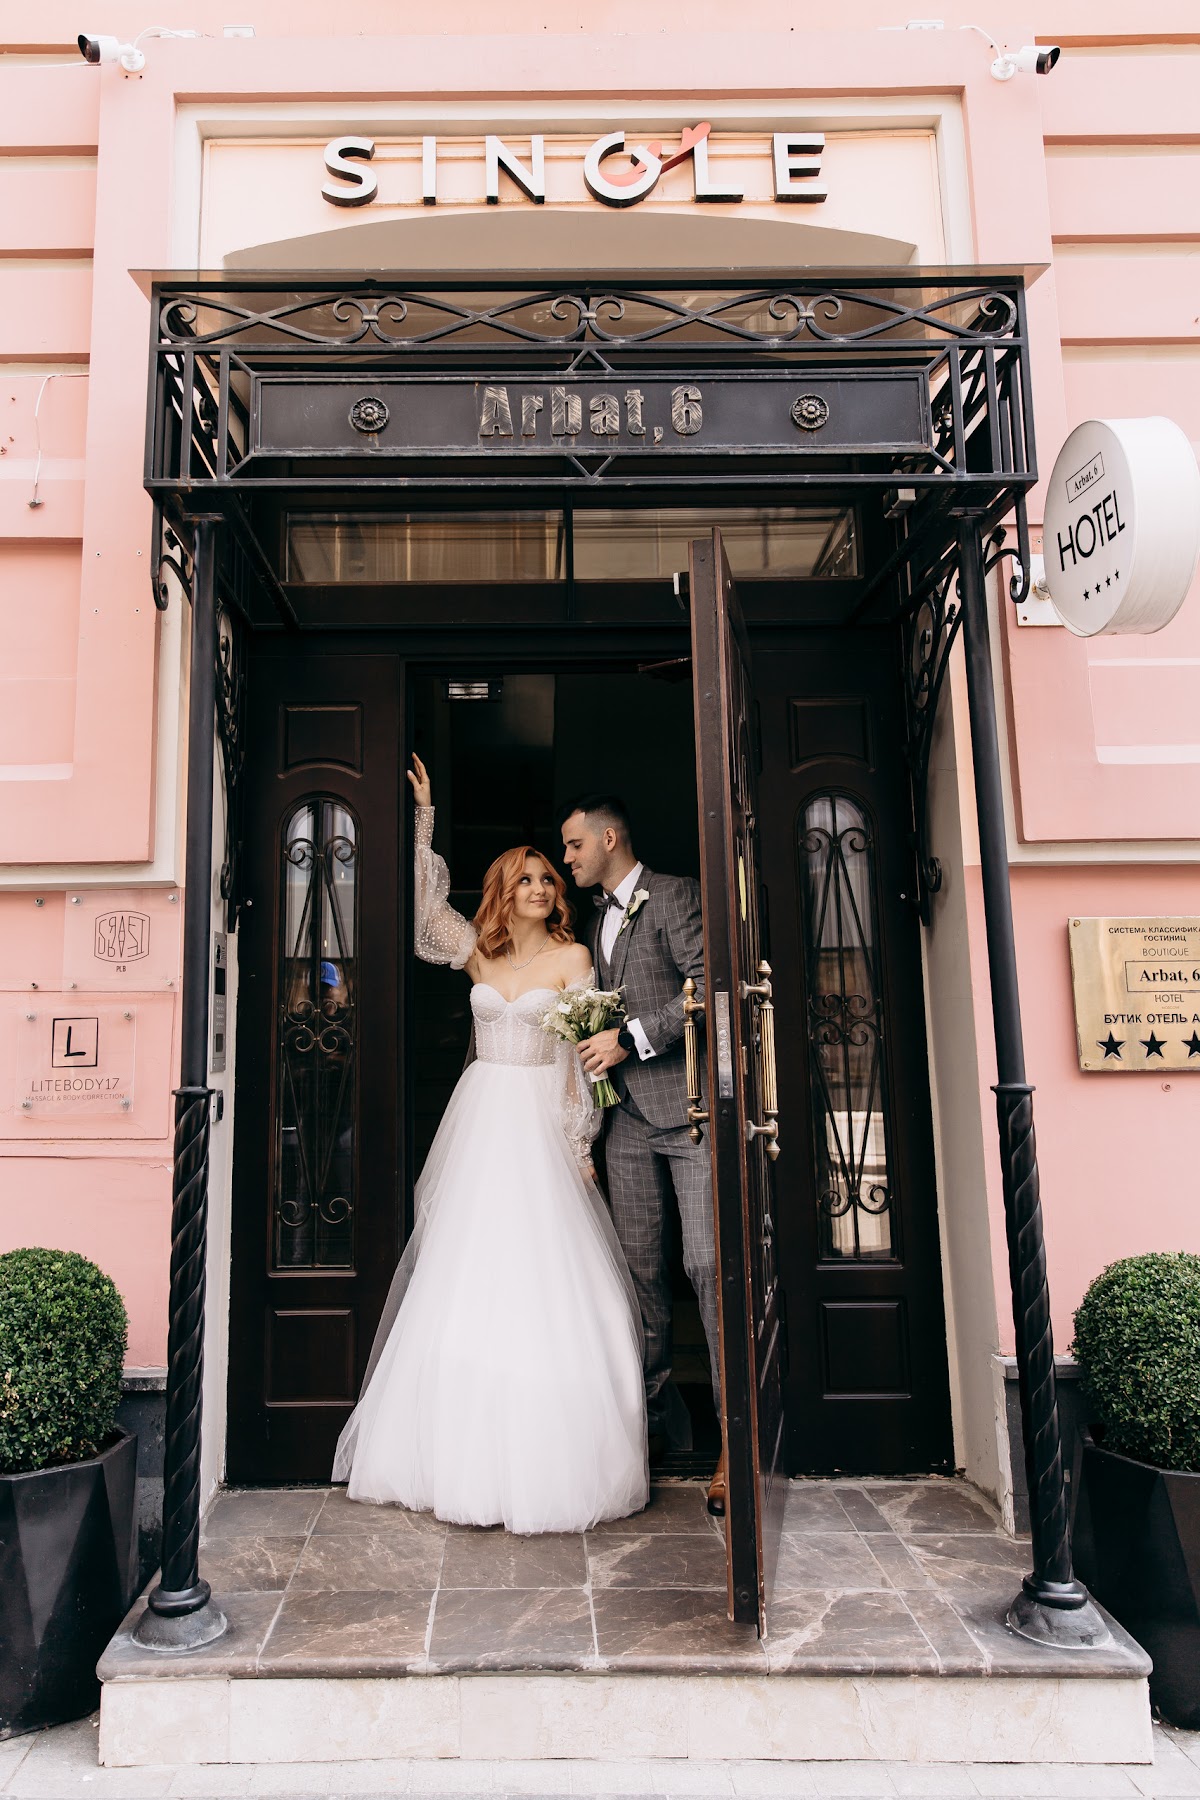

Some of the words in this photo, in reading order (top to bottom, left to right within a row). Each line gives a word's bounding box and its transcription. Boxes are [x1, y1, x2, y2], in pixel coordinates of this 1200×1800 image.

[321, 131, 828, 207] SINGLE
[1093, 463, 1098, 475] 6
[1057, 490, 1126, 572] HOTEL
[1142, 948, 1189, 957] BOUTIQUE
[1139, 969, 1188, 983] Arbat,
[1192, 968, 1200, 981] 6
[1154, 994, 1185, 1003] HOTEL
[1104, 1014, 1142, 1024] БУТИК
[1146, 1013, 1188, 1023] ОТЕЛЬ
[64, 1026, 87, 1057] L
[31, 1078, 120, 1092] LITEBODY17
